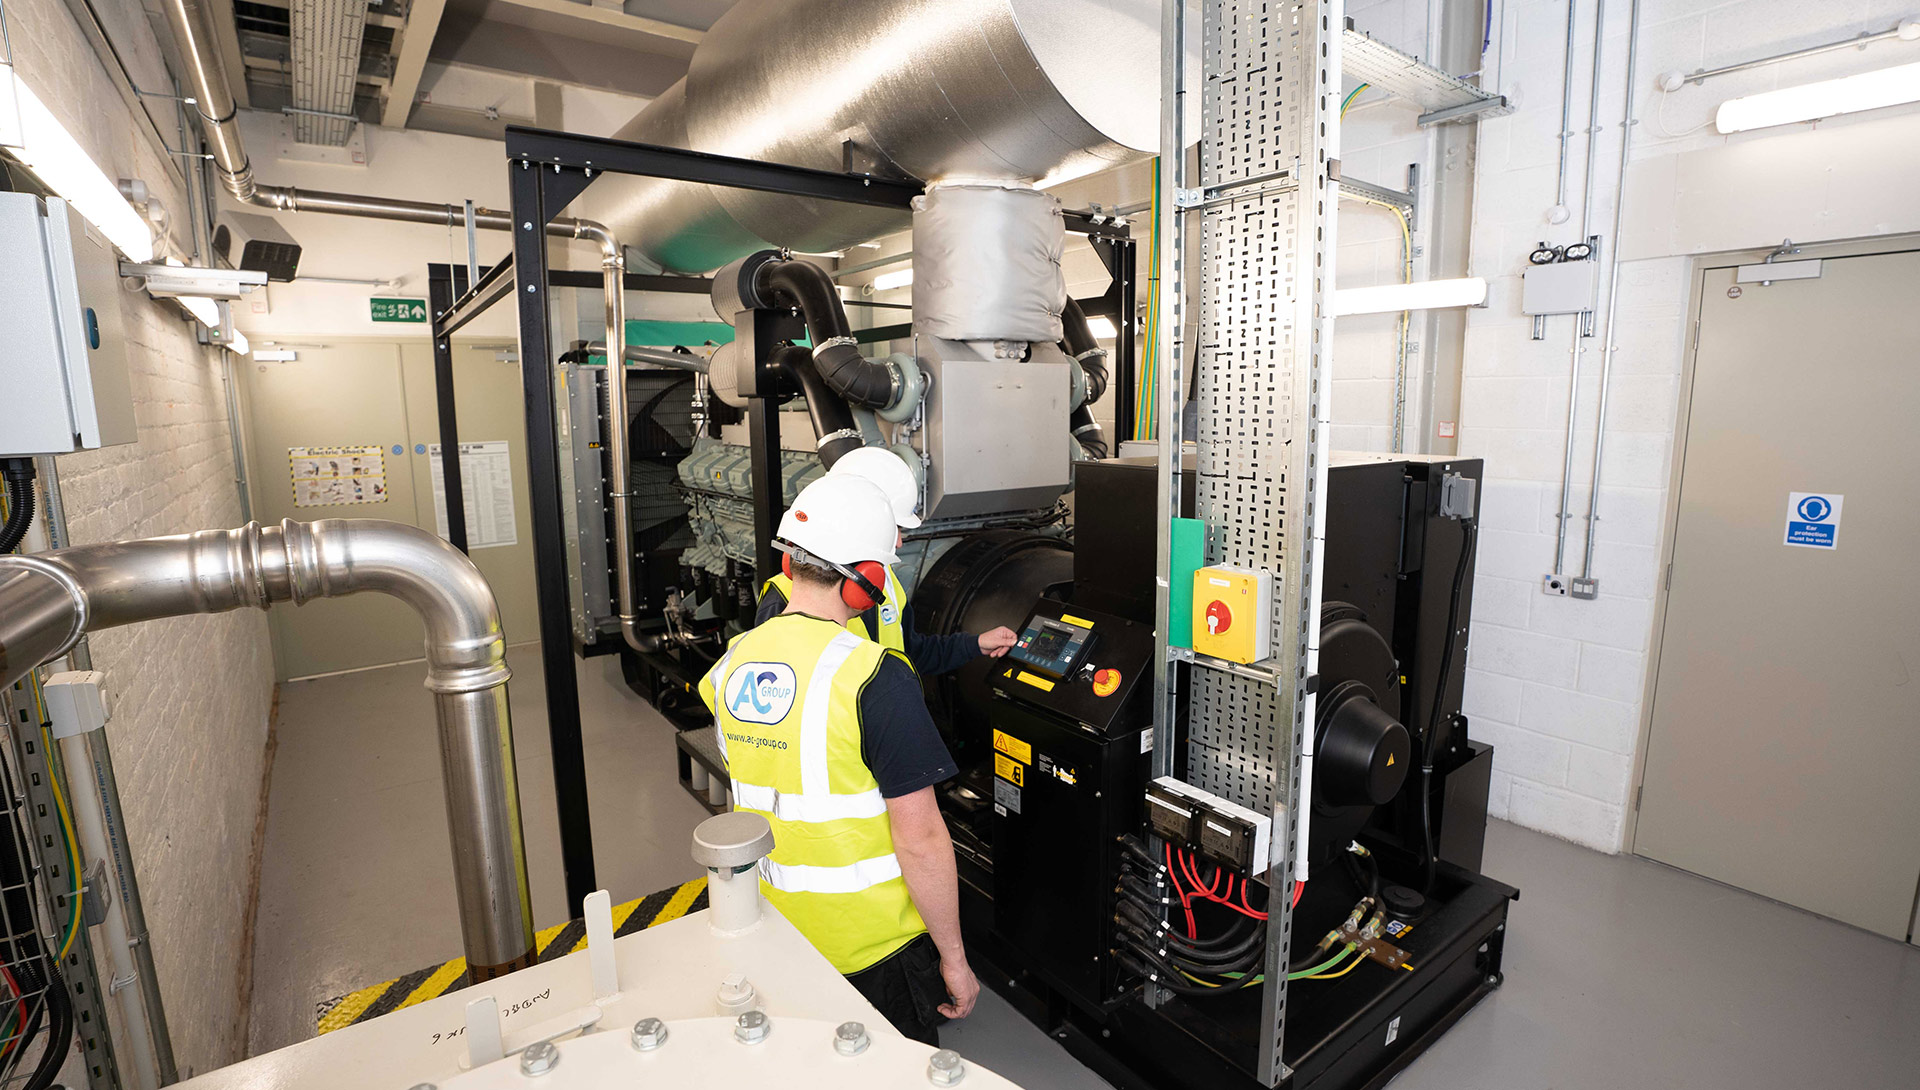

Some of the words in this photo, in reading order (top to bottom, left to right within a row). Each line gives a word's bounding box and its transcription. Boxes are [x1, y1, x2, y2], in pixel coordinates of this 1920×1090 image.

[732, 671, 778, 714] AC
[761, 686, 791, 699] GROUP
[727, 733, 787, 749] www.ac-groupco
